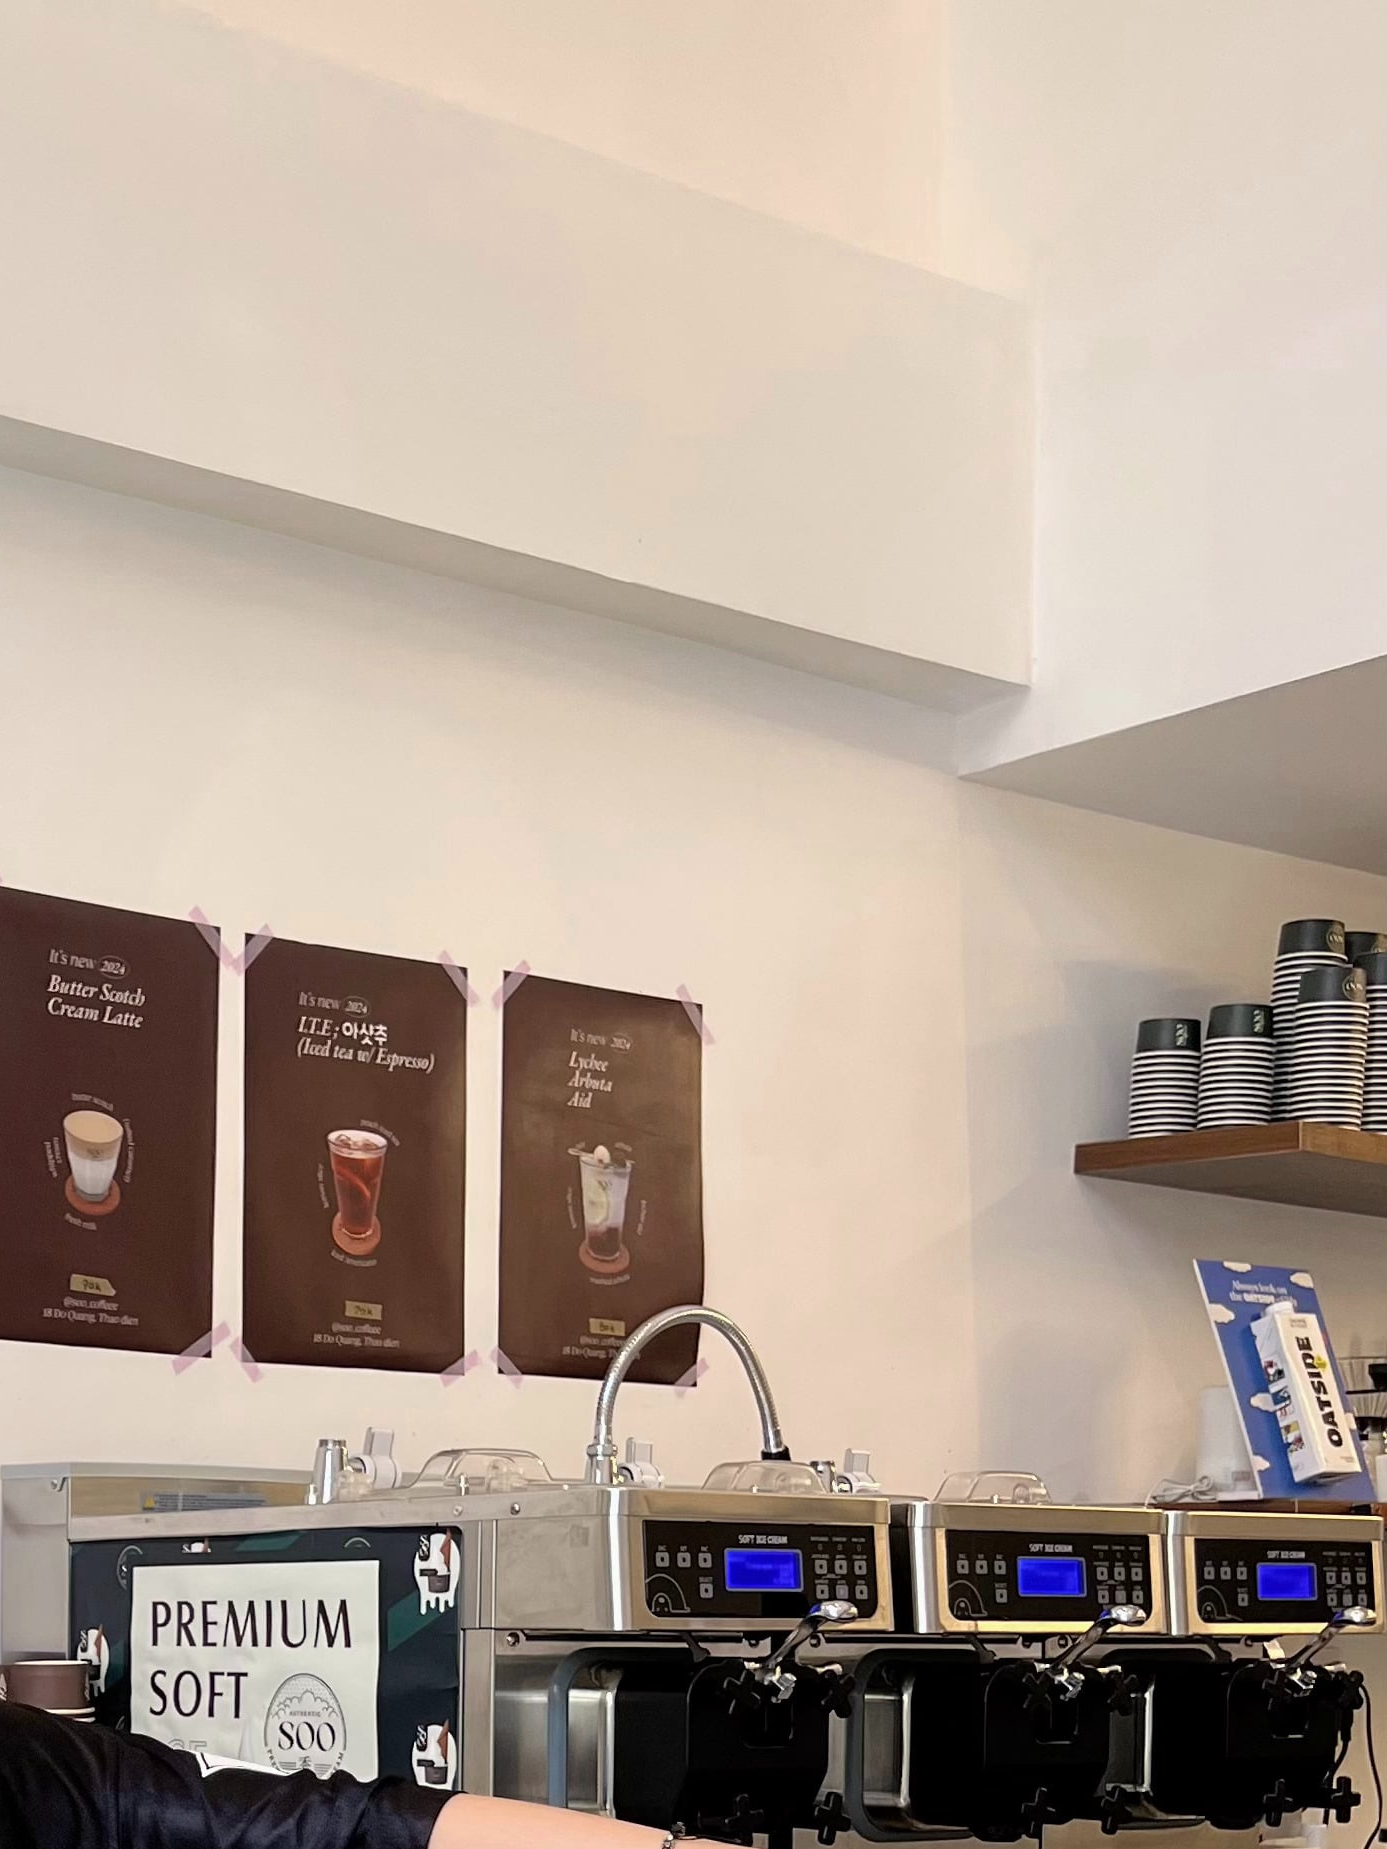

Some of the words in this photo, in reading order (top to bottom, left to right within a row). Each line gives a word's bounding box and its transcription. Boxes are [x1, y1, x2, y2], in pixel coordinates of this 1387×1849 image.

[70, 955, 94, 969] new
[100, 960, 126, 975] 2024
[47, 974, 99, 998] Butter
[99, 983, 146, 1007] Scotch
[47, 996, 99, 1021] Cream
[102, 1005, 144, 1028] Latte
[341, 1021, 388, 1046] 아샷추
[297, 1036, 332, 1058] (Iced
[333, 1045, 353, 1060] tea
[375, 1047, 435, 1074] Espresso)
[568, 1051, 609, 1073] Lychee
[566, 1091, 593, 1108] Aid
[1295, 1336, 1343, 1448] OATSIDE
[738, 1535, 755, 1545] SOFT
[767, 1535, 788, 1545] CREAM
[151, 1599, 353, 1649] PREMIUM
[149, 1669, 249, 1719] SOFT
[278, 1720, 336, 1752] SOO
